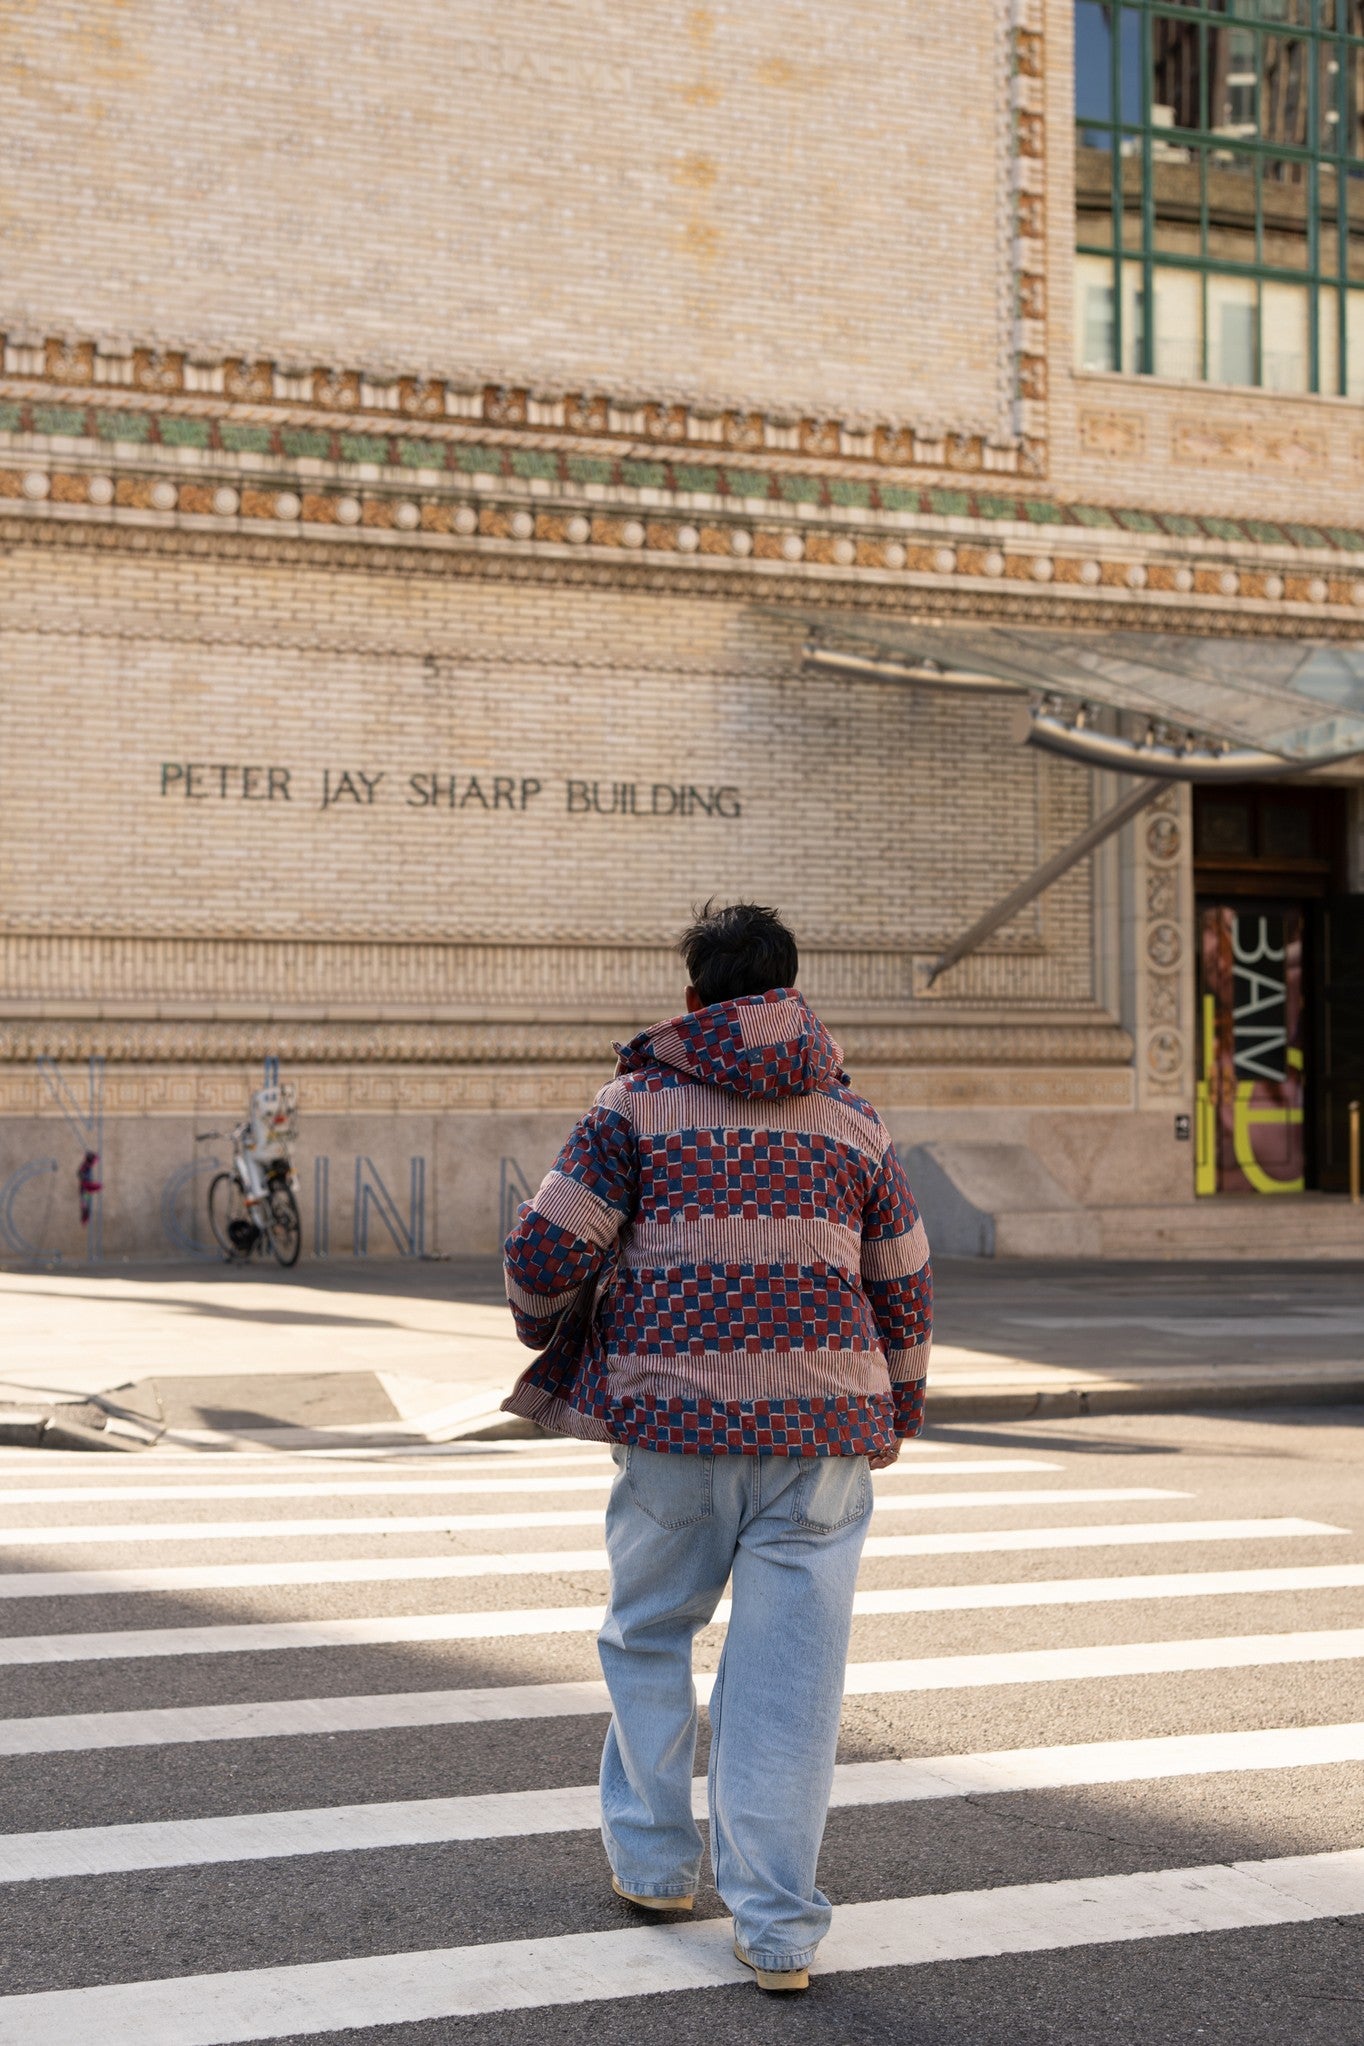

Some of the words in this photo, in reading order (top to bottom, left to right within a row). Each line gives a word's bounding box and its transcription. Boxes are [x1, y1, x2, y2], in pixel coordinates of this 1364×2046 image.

[160, 762, 291, 801] PETER
[320, 768, 384, 811] JAY
[406, 772, 543, 812] SHARP
[567, 779, 742, 819] BUILDING
